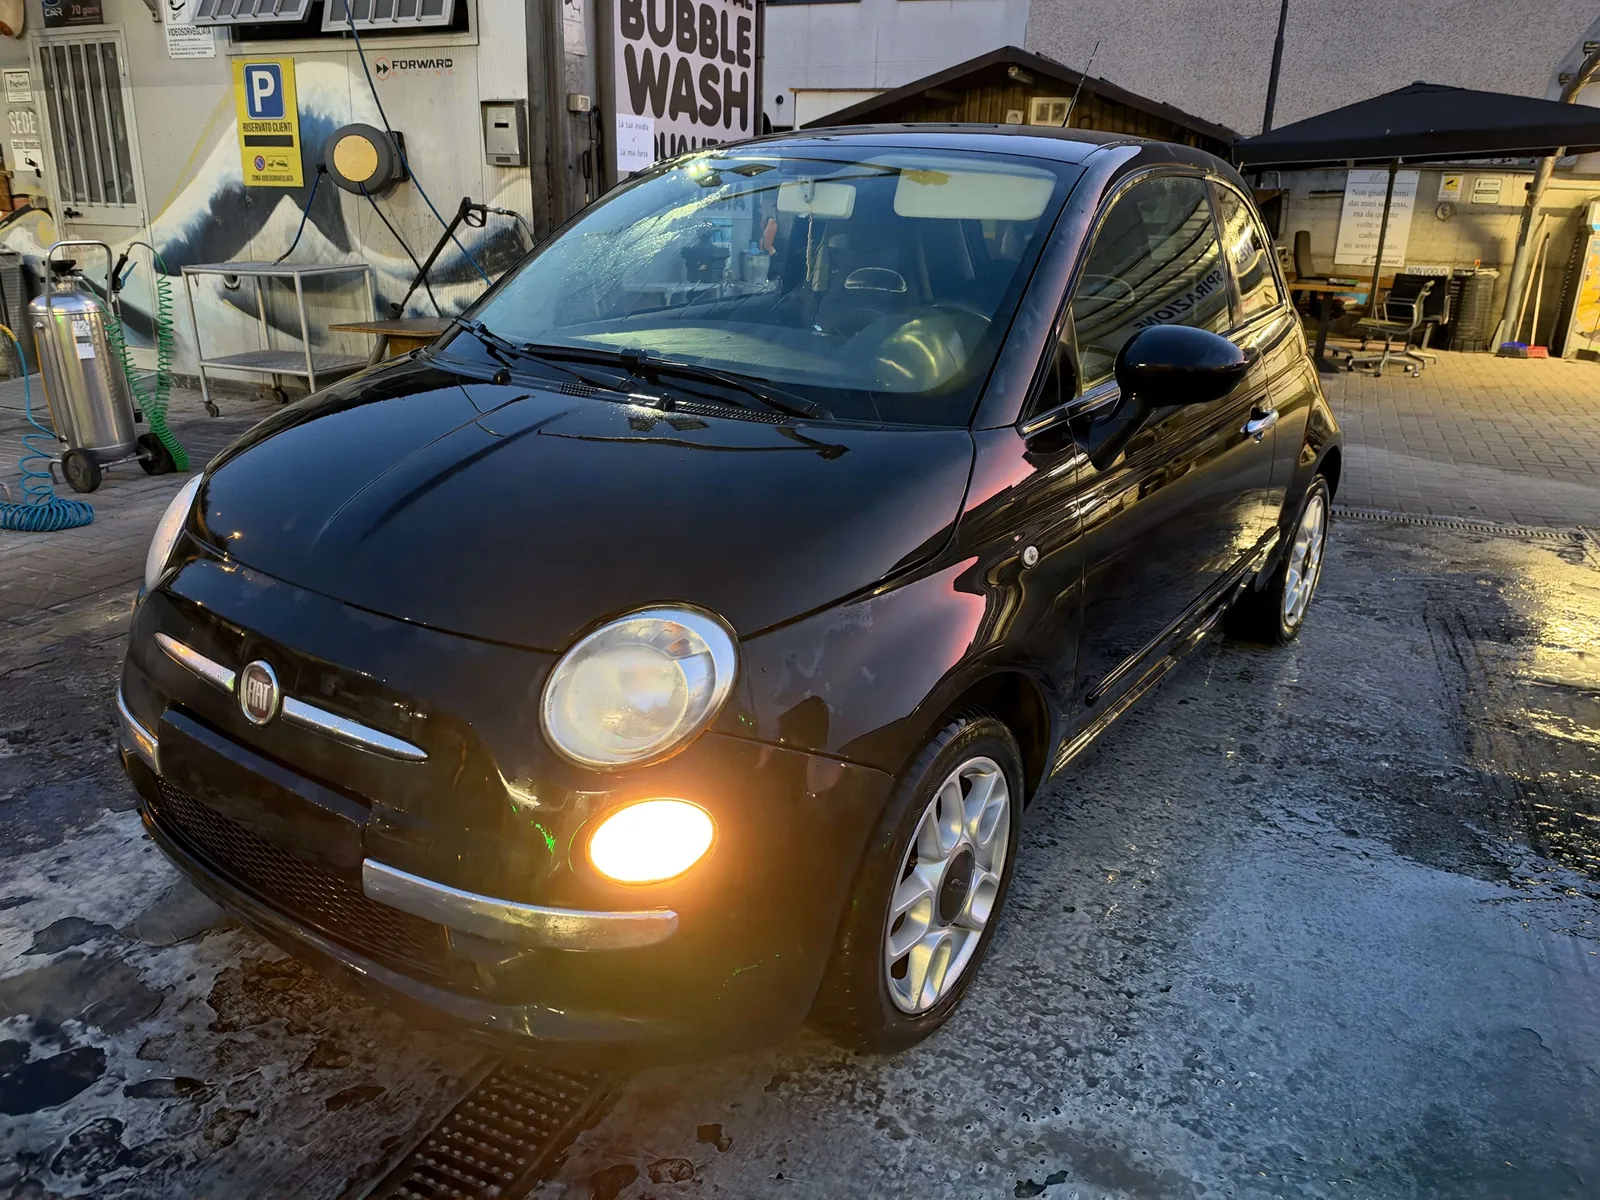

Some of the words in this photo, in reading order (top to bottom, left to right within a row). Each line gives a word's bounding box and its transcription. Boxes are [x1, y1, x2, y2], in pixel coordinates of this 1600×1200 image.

[620, 0, 752, 69] BUBBLE
[391, 58, 453, 70] FORWARD
[251, 70, 275, 113] P
[624, 43, 749, 132] WASH
[8, 110, 37, 134] SEDE
[242, 122, 272, 133] RISERVATO
[272, 122, 293, 133] CLIENTI
[1365, 210, 1374, 218] da
[247, 676, 273, 712] FIAT
